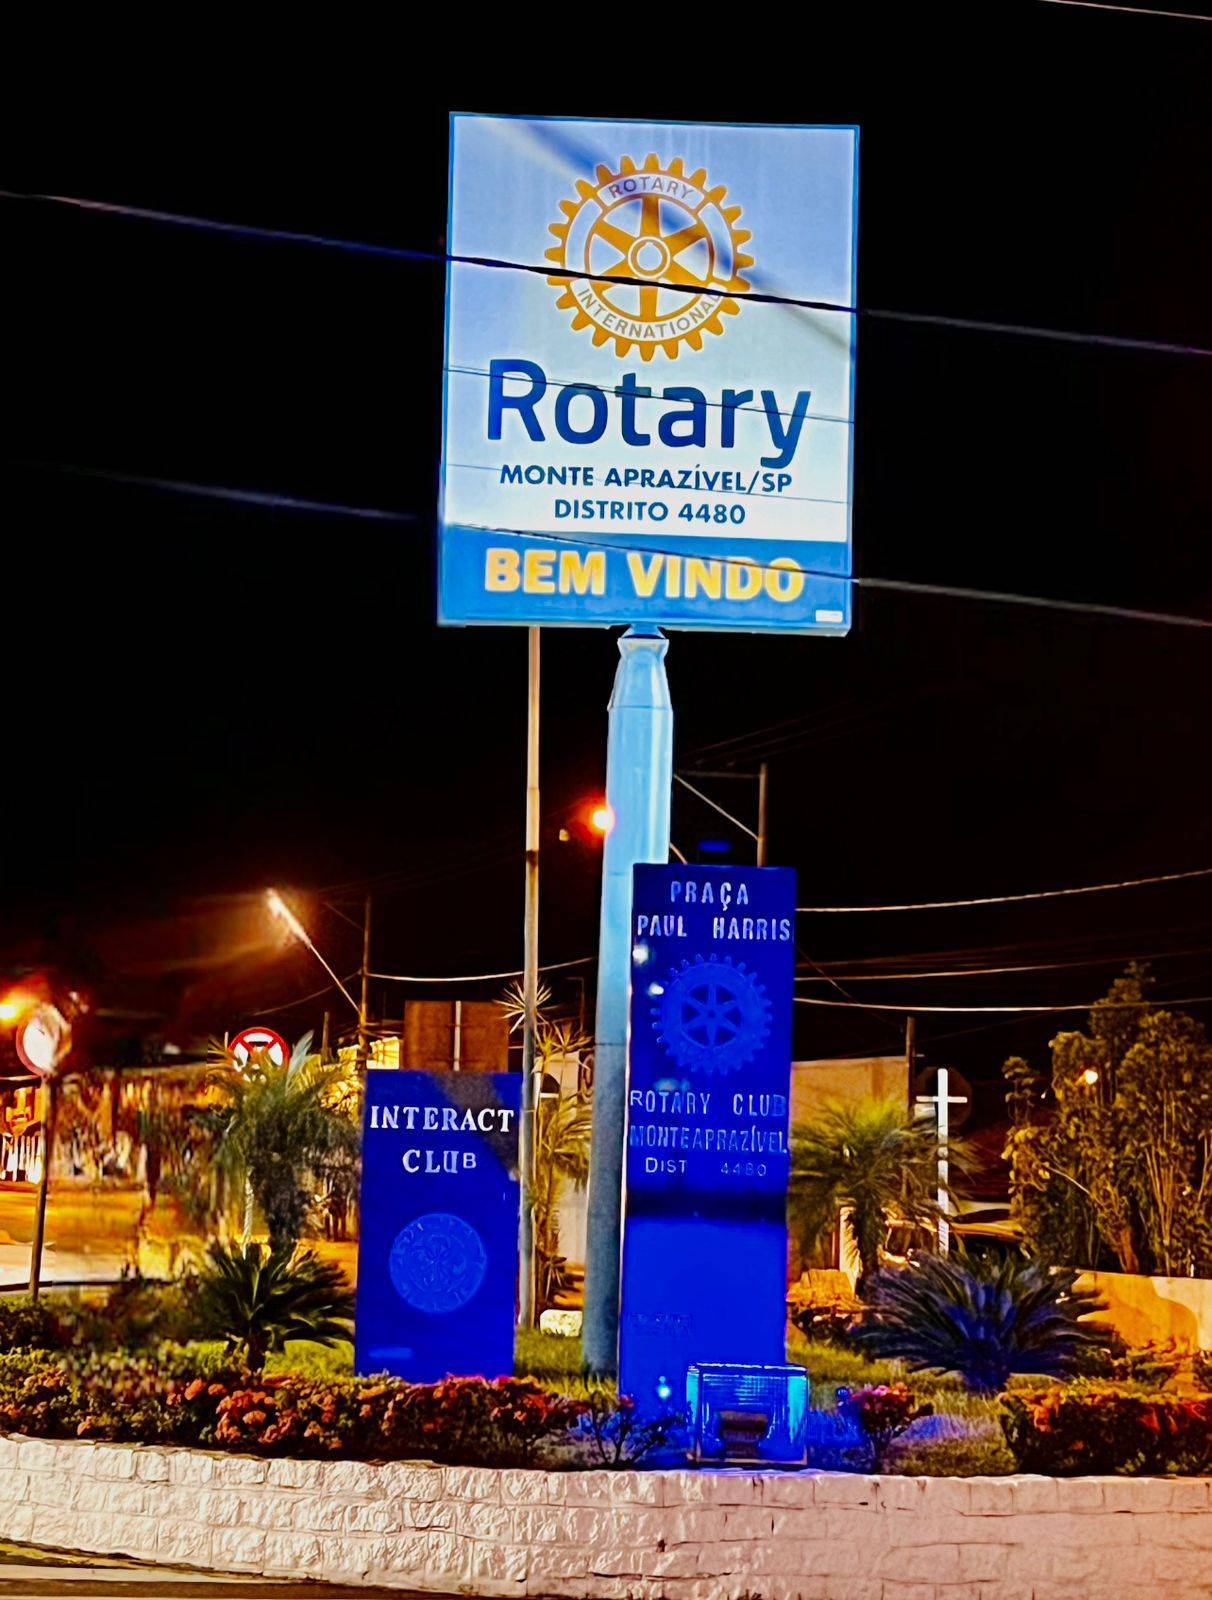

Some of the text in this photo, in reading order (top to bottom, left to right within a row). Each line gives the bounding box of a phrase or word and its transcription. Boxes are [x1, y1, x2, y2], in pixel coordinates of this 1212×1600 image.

[608, 176, 695, 199] ROTARY
[577, 287, 721, 340] INTERNATIONAL
[487, 358, 811, 469] Rotary
[500, 464, 793, 494] MONTE APRAZÍVEL/SP
[554, 499, 746, 525] DISTRITO 4480
[485, 547, 805, 602] BEM VINDO
[670, 881, 749, 911] PRAÇA
[637, 915, 791, 941] PAUL HARRIS
[630, 1090, 787, 1117] ROTARY CLUB
[370, 1105, 515, 1132] INTERACT
[402, 1149, 477, 1174] CLUB
[645, 1157, 688, 1174] DIST
